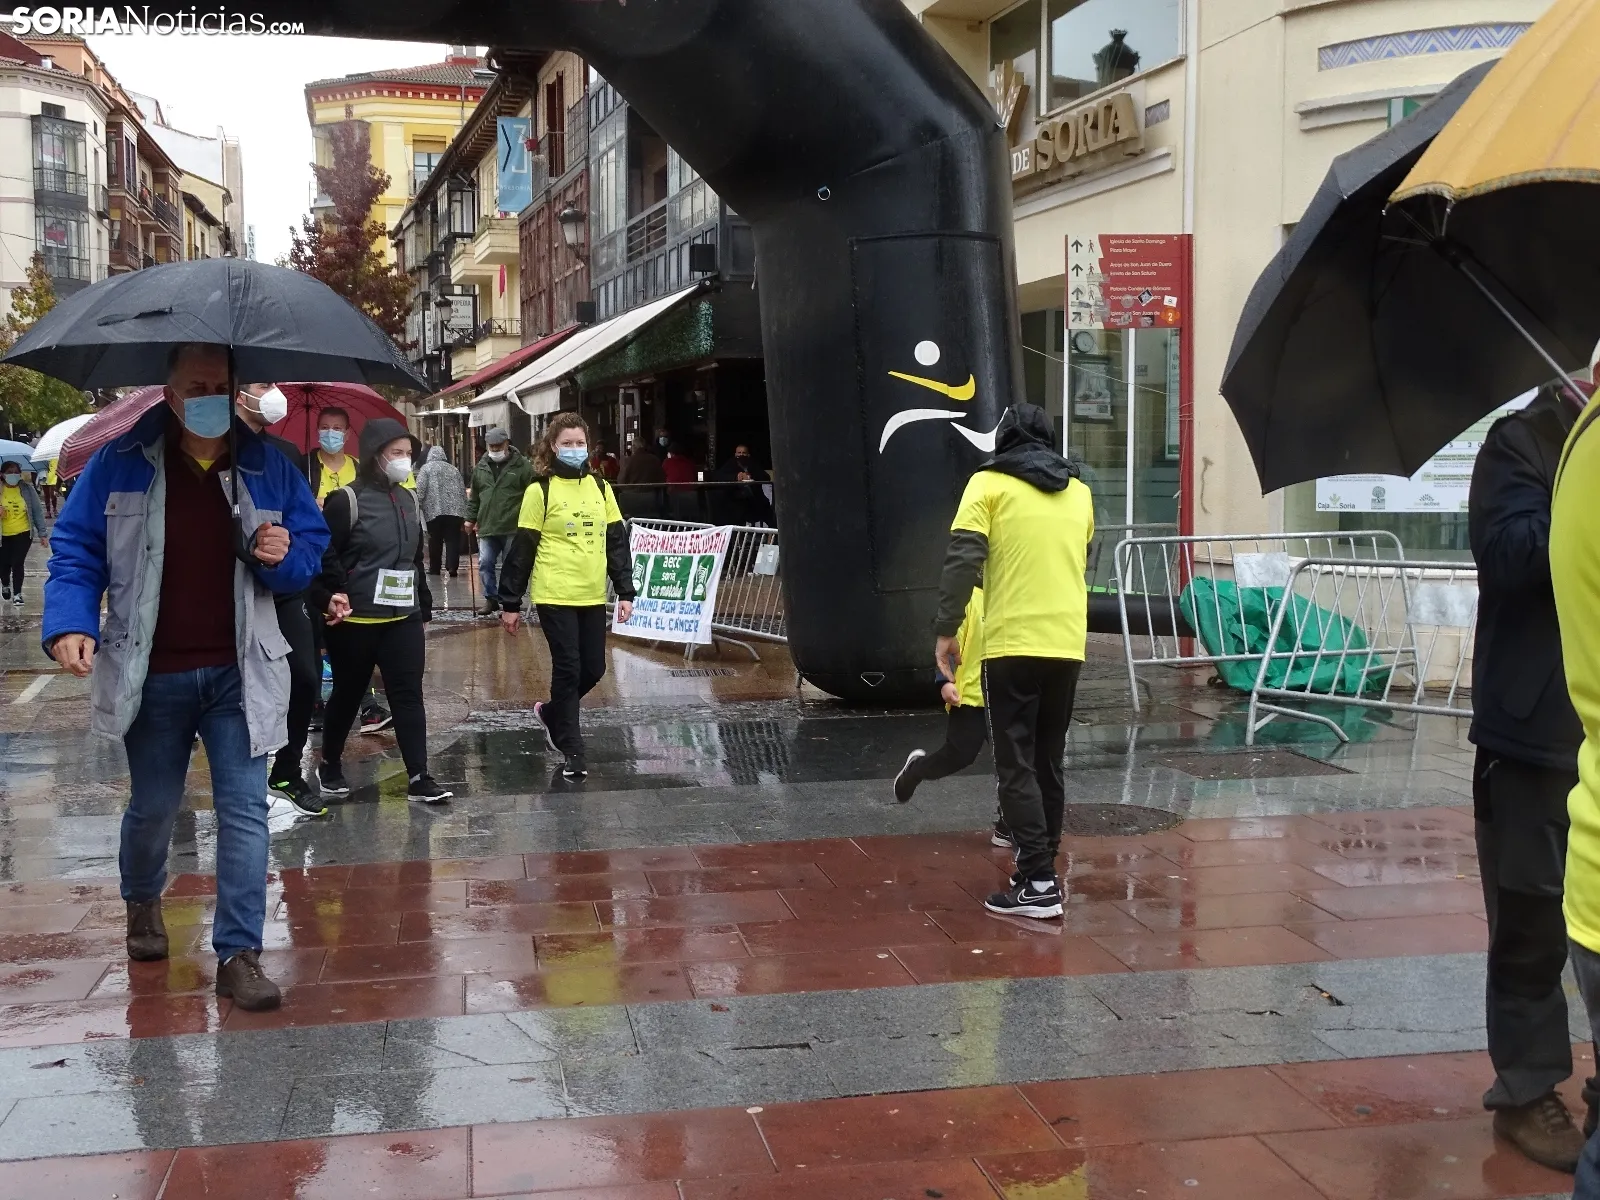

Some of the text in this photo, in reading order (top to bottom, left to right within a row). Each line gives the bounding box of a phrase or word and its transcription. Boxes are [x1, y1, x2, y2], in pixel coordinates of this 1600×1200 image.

[1012, 92, 1139, 175] DE SORIA
[1168, 312, 1173, 322] 2
[1317, 502, 1330, 510] Caja
[660, 601, 676, 614] POR
[655, 617, 666, 630] EL
